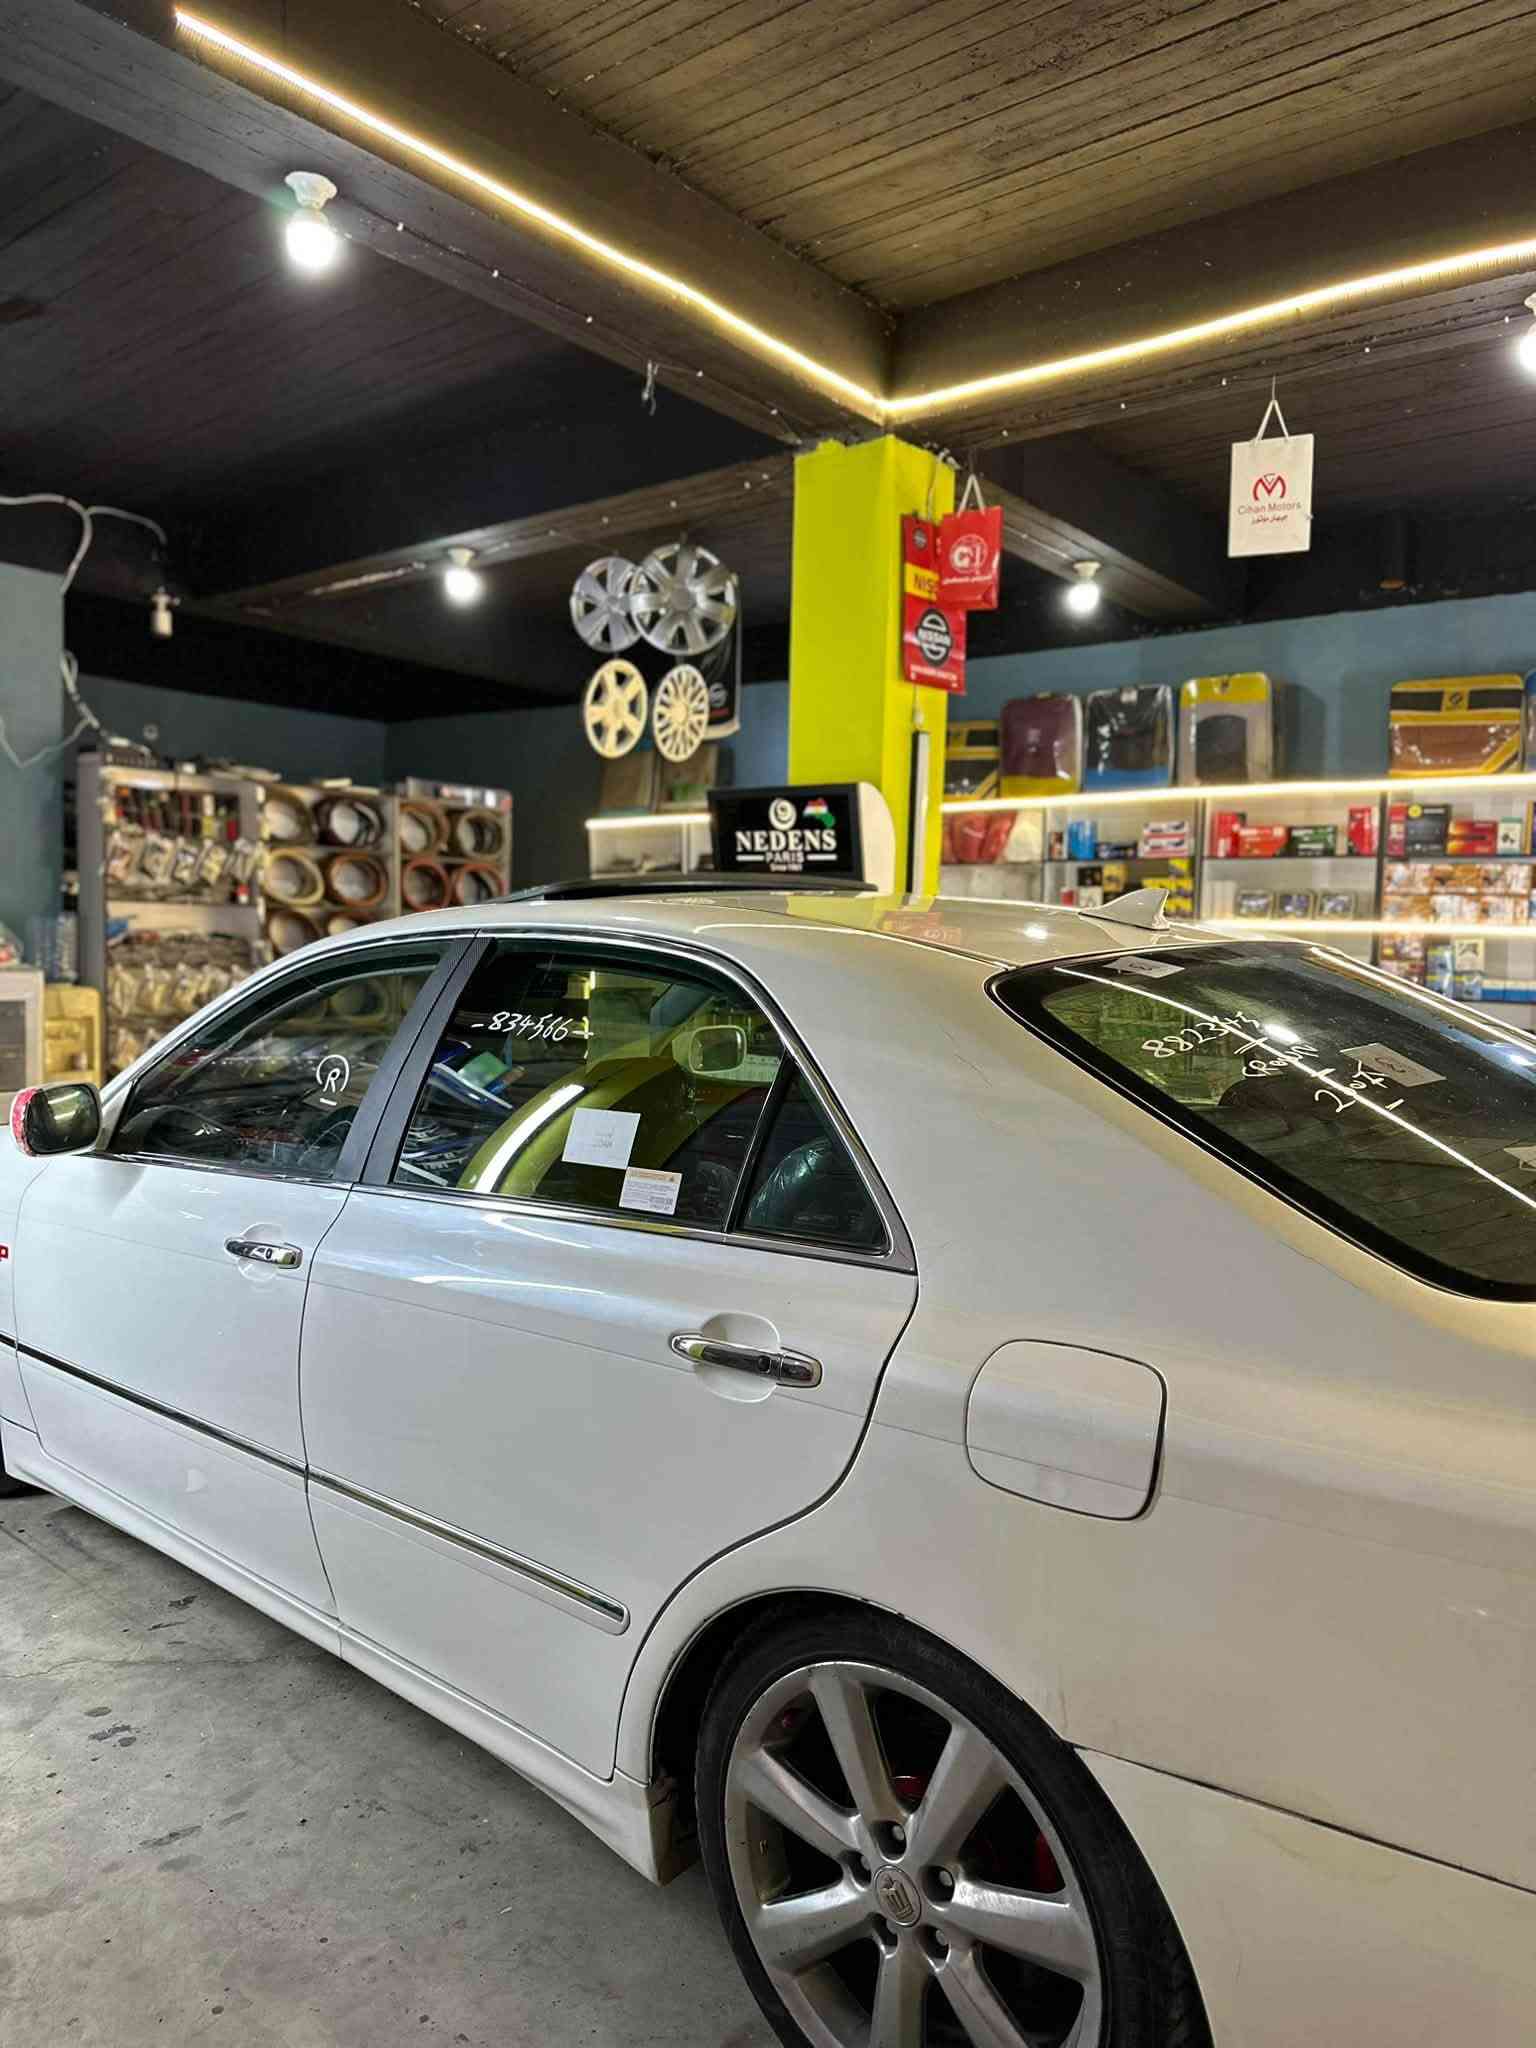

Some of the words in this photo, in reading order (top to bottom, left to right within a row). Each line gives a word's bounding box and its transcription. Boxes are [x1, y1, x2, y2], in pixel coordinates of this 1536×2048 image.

[1267, 501, 1302, 512] Motors
[735, 829, 837, 852] NEDENS
[765, 851, 804, 863] PARIS
